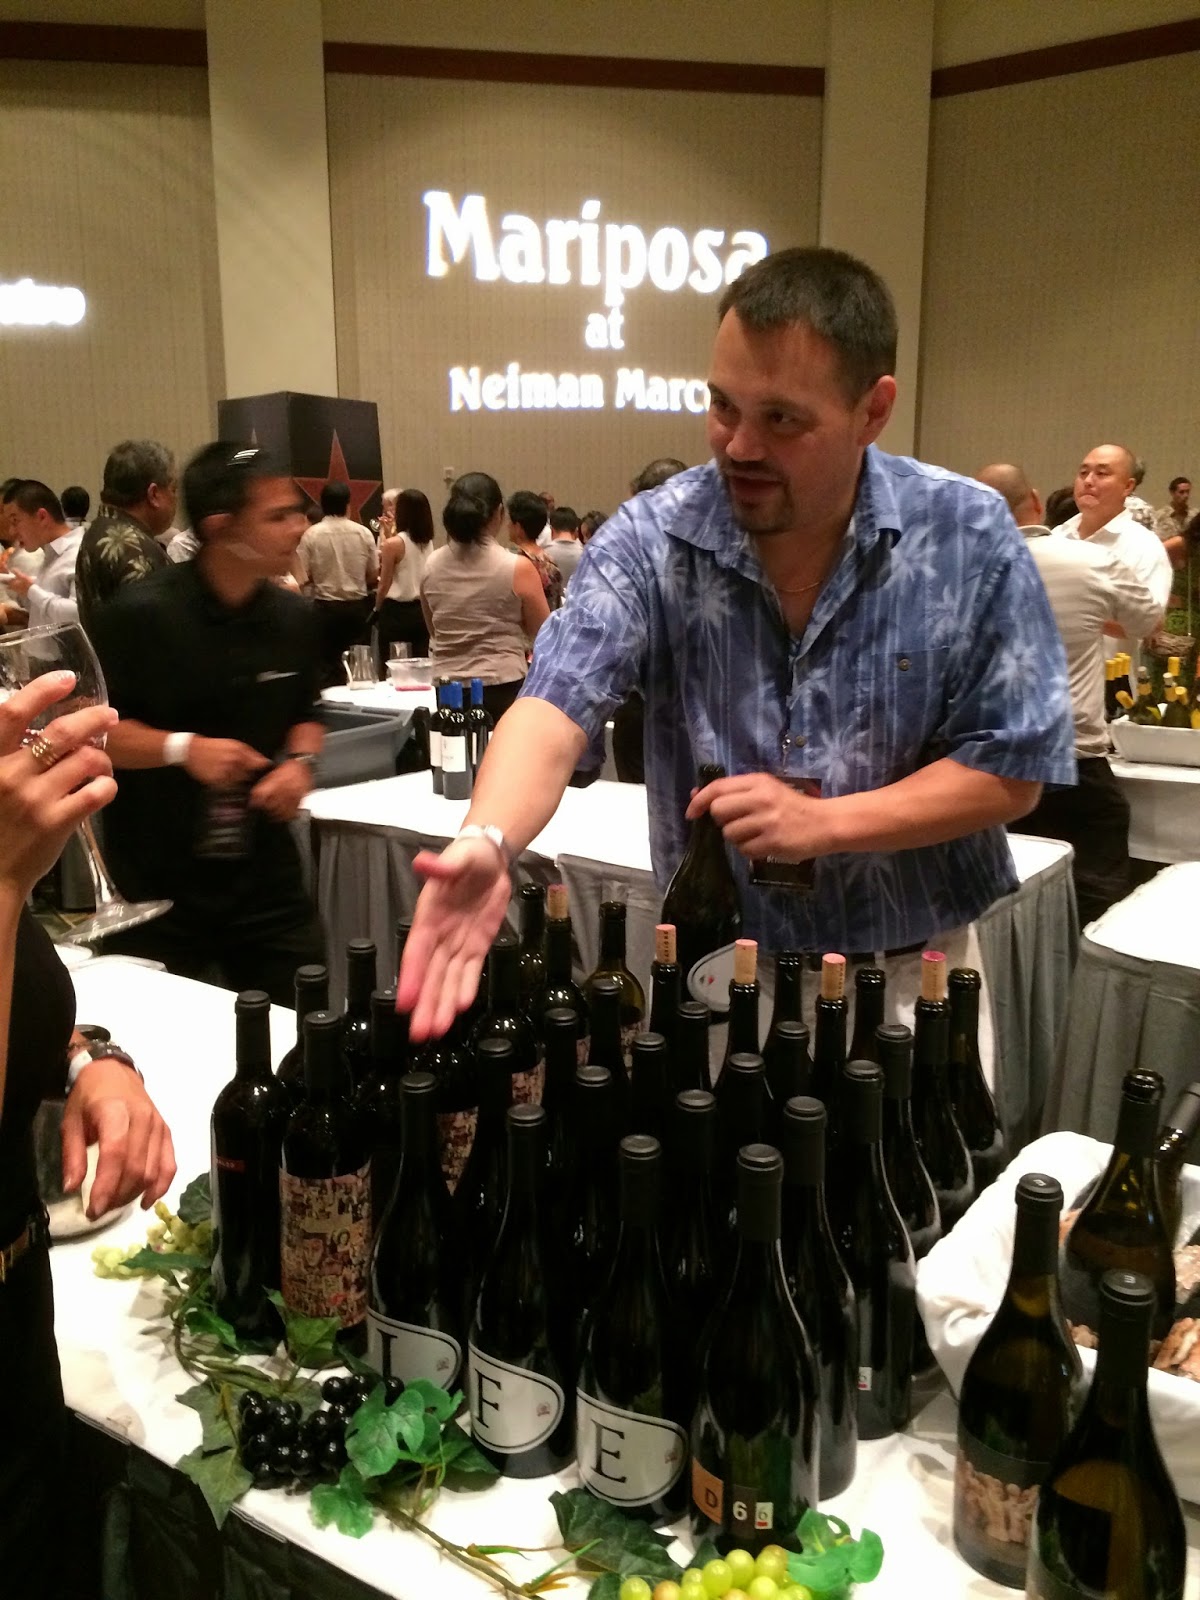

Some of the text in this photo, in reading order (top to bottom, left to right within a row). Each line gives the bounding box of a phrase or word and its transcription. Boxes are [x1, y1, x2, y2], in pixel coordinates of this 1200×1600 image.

[424, 190, 768, 307] Mariposa
[584, 306, 625, 350] at
[449, 361, 605, 411] Neiman
[475, 1367, 502, 1429] F
[591, 1418, 627, 1484] E
